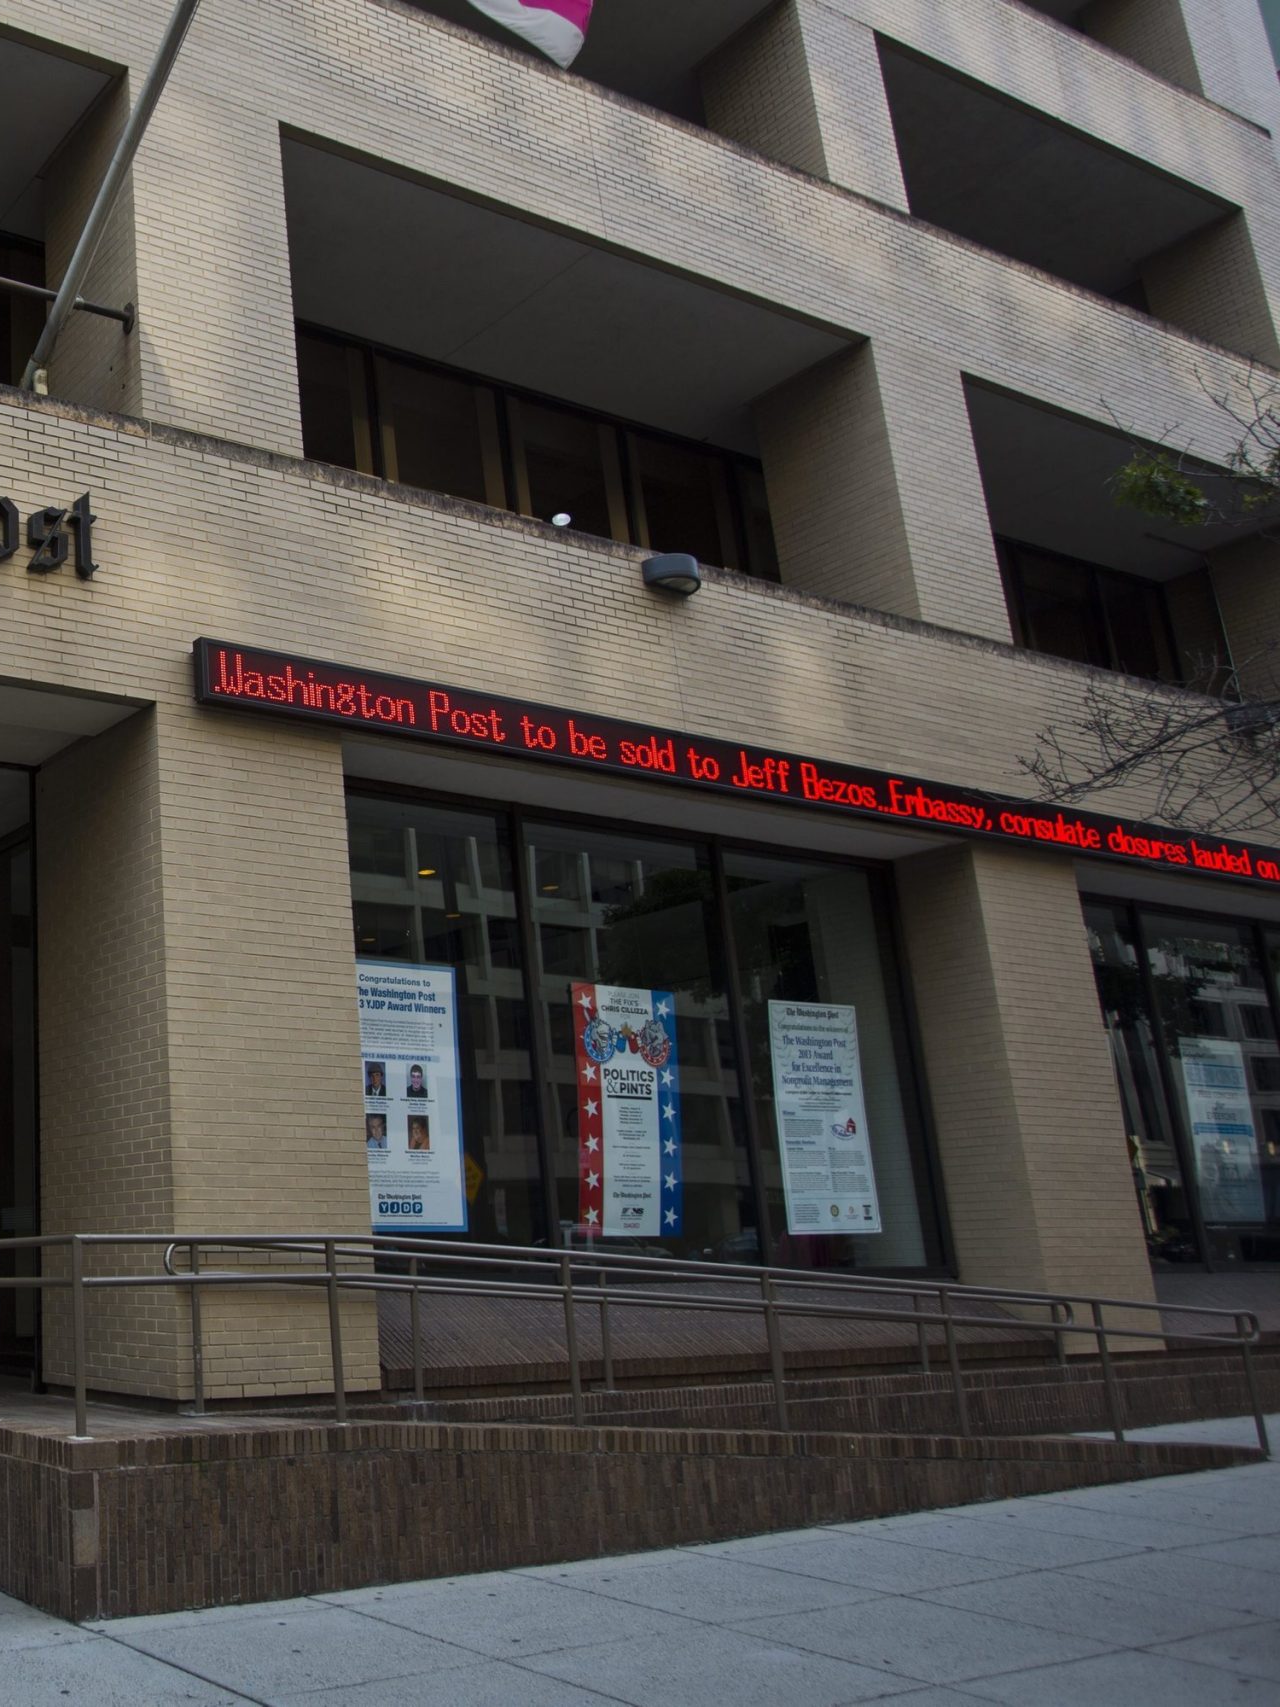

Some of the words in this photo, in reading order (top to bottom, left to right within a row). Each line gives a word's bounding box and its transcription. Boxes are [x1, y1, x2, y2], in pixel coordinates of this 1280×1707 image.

[219, 650, 415, 724] Washington
[429, 690, 505, 742] Post
[520, 716, 556, 749] to
[569, 720, 607, 759] be
[620, 736, 676, 773] sold
[687, 748, 720, 780] to
[733, 751, 789, 793] Jeff
[1000, 811, 1101, 849] consulate
[1108, 826, 1188, 864] closures
[1190, 839, 1253, 876] lauded
[358, 974, 421, 987] Congratulations
[423, 979, 431, 987] to
[370, 988, 416, 1001] Washington
[418, 991, 436, 1002] Post
[610, 997, 622, 1005] THE
[366, 999, 386, 1010] YJDP
[387, 1001, 413, 1012] Award
[414, 1002, 446, 1015] Winners
[601, 1004, 620, 1012] CHRIS
[621, 1006, 649, 1015] CILLIZZA
[786, 1007, 795, 1016] The
[796, 1008, 826, 1019] Washington
[827, 1010, 839, 1020] Post
[783, 1035, 794, 1045] The
[795, 1036, 832, 1049] Washington
[833, 1039, 846, 1048] Post
[814, 1050, 833, 1060] Award
[792, 1061, 800, 1072] for
[802, 1062, 832, 1073] Excellence
[834, 1063, 841, 1073] in
[603, 1068, 654, 1082] POLITICS
[782, 1075, 812, 1088] Nonprofit
[813, 1076, 853, 1089] Management
[606, 1079, 618, 1094] &
[620, 1083, 652, 1095] PINTS
